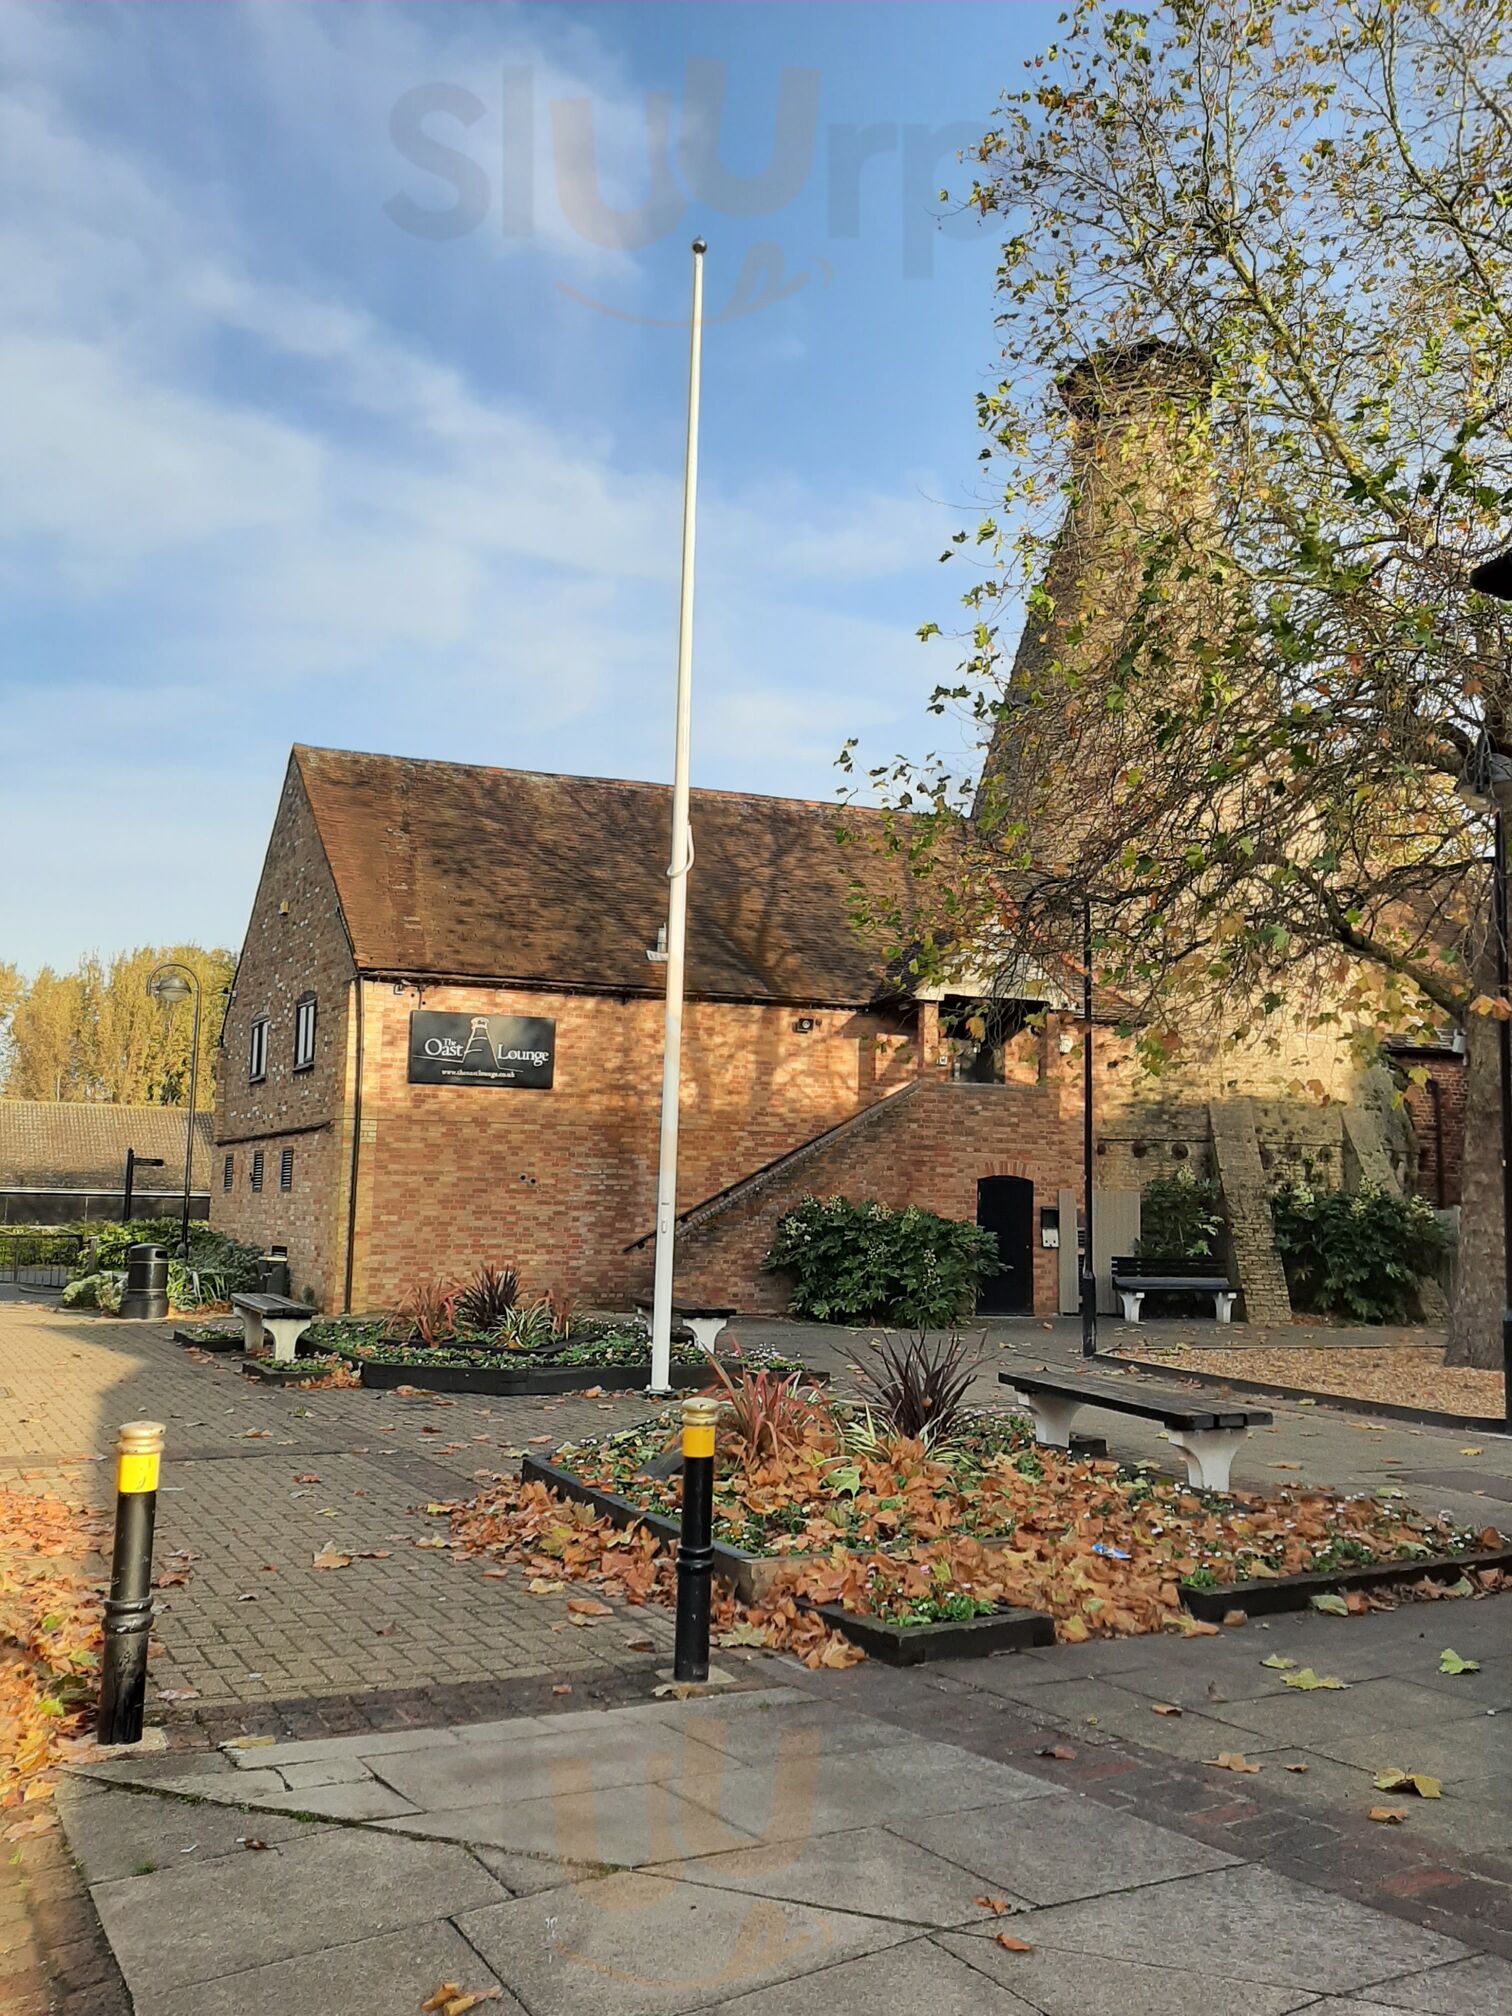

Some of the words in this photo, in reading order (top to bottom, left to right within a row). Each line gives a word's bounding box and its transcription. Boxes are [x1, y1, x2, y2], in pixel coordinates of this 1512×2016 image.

[442, 1038, 457, 1046] The
[424, 1038, 463, 1056] Oast
[498, 1044, 549, 1066] Lounge
